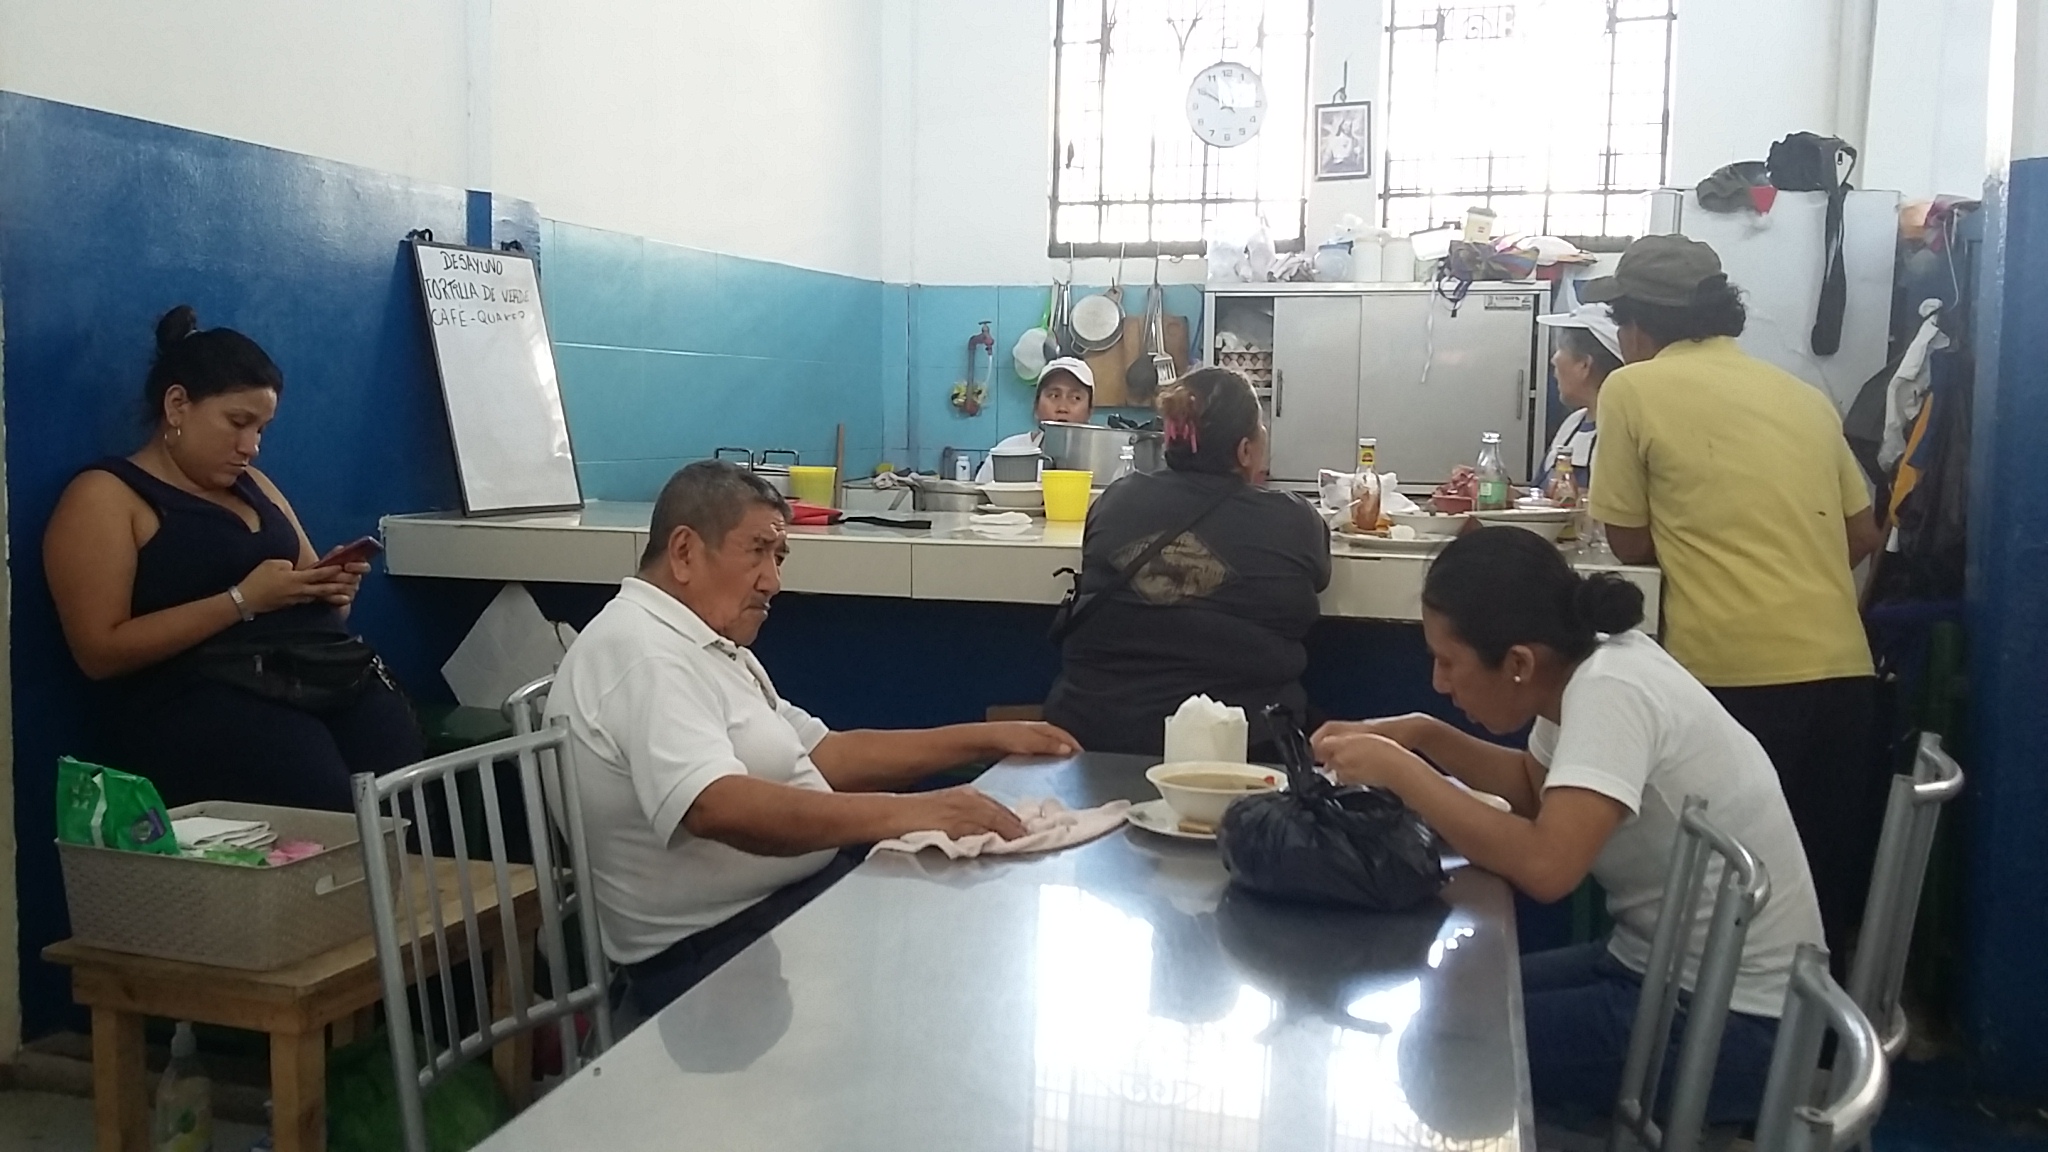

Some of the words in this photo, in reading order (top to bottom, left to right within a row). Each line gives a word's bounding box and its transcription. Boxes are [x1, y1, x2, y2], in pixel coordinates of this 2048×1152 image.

[1222, 69, 1233, 77] 12
[1208, 74, 1216, 82] 11
[1249, 115, 1256, 123] 4
[1209, 129, 1215, 137] 7
[440, 251, 503, 275] DESAYUNO
[481, 284, 496, 302] DE
